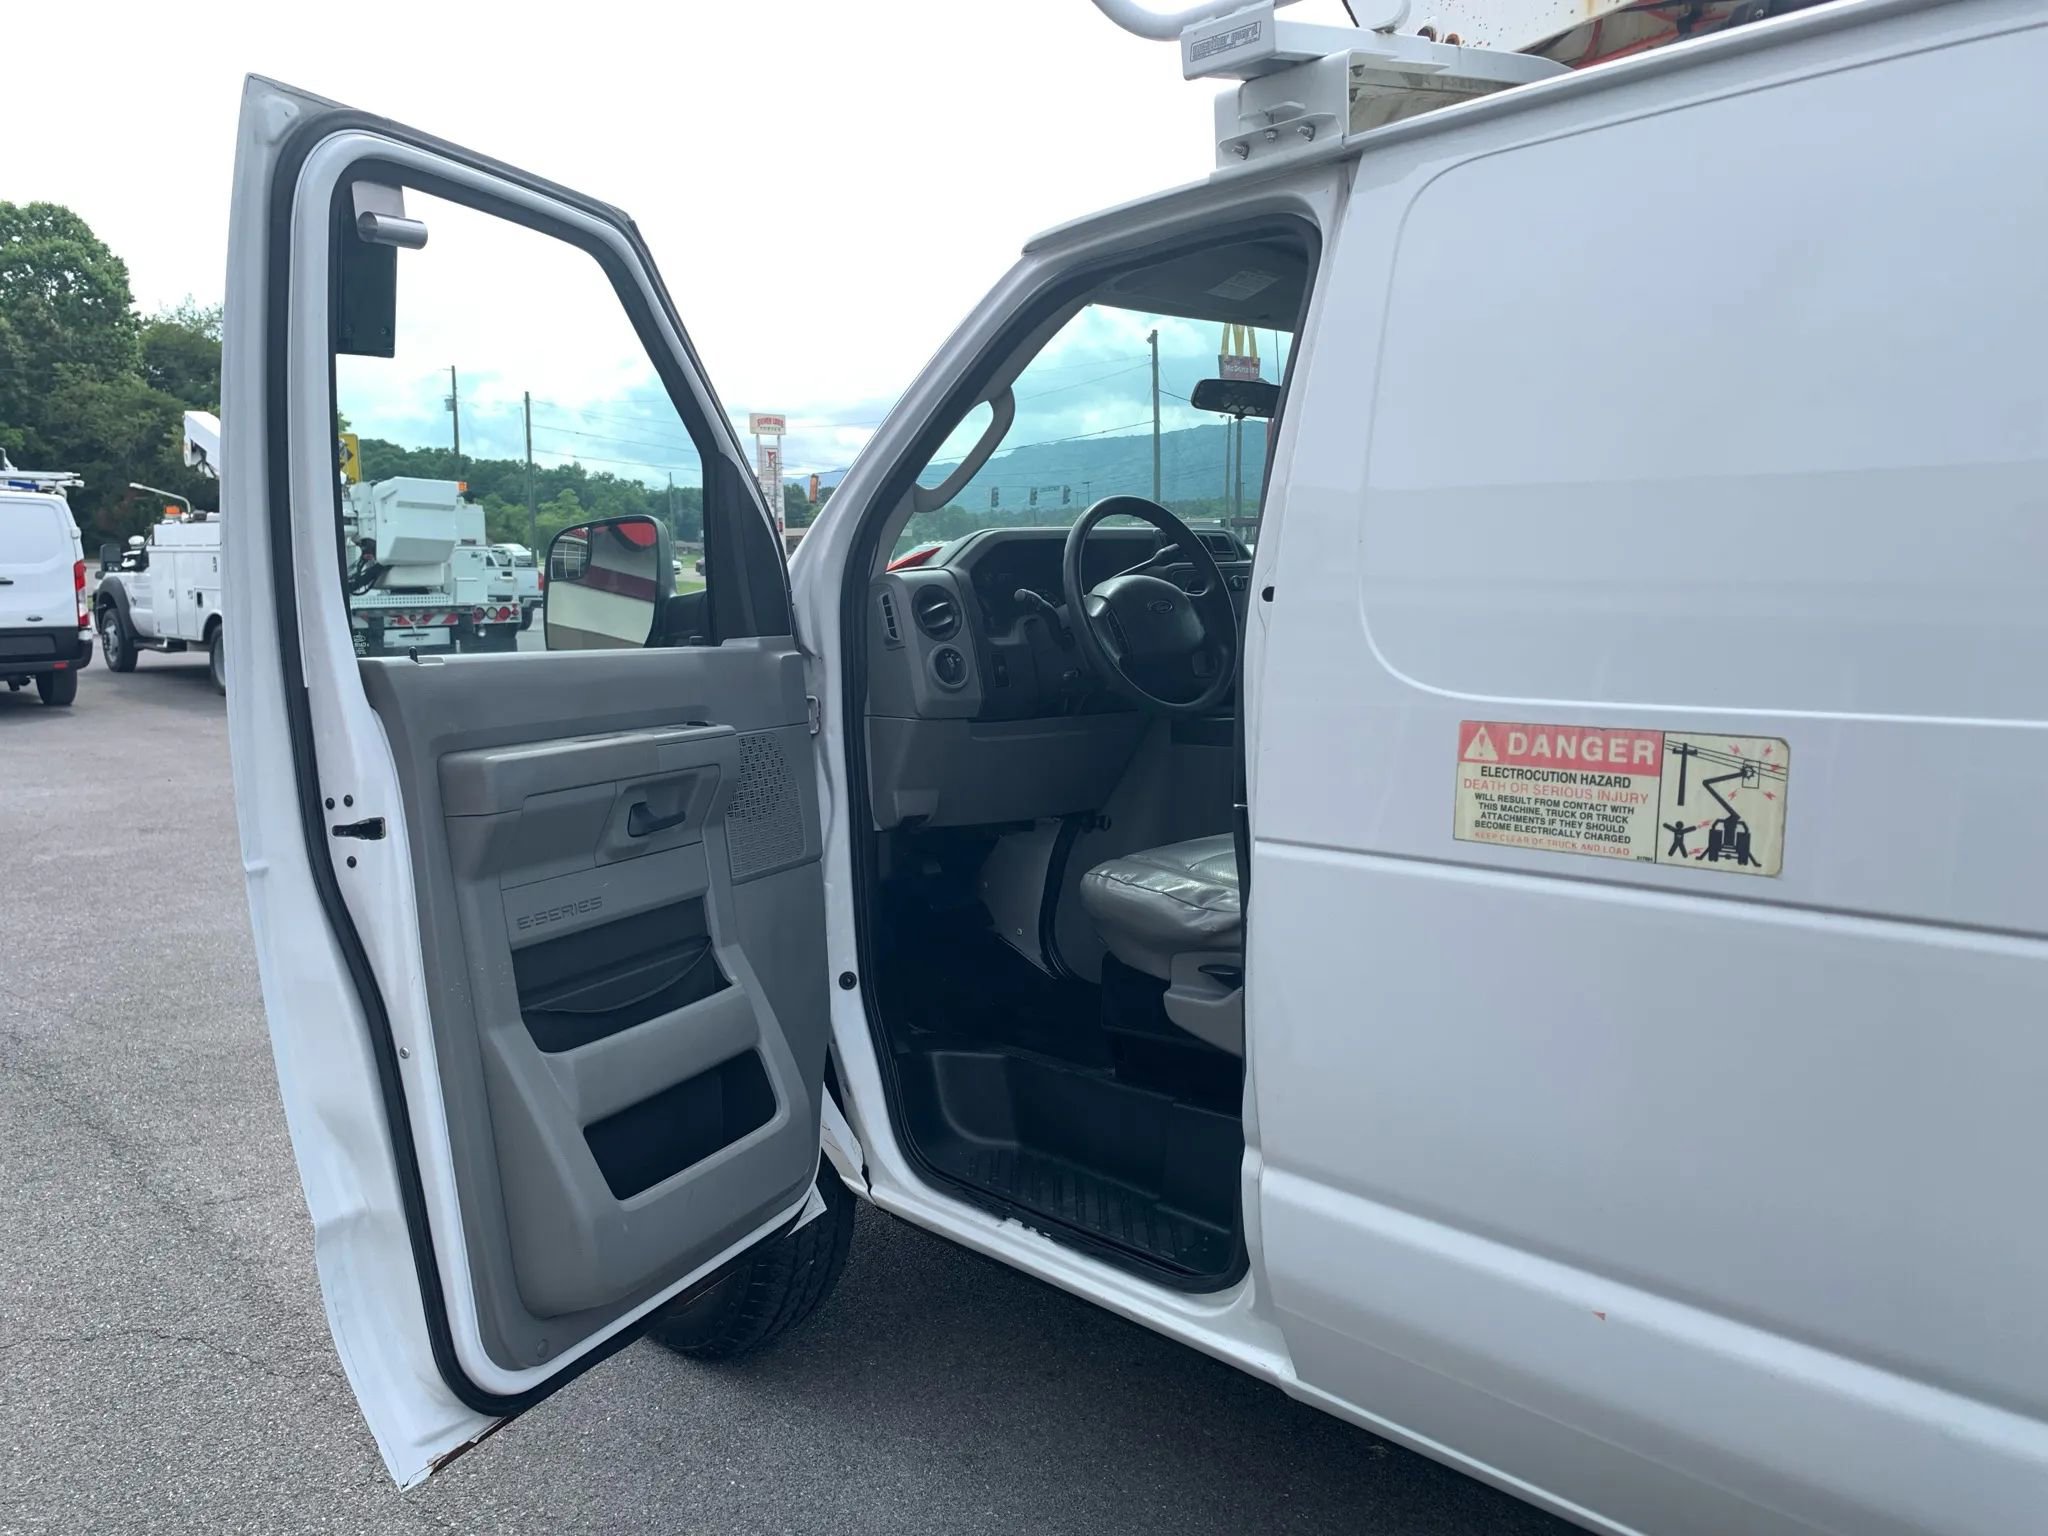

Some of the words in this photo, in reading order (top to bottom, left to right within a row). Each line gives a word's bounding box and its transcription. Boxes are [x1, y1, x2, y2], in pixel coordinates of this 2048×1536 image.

[1508, 731, 1656, 765] DANGER
[1481, 766, 1577, 784] ELECTROCUTION
[1580, 774, 1631, 789] HAZARD
[1463, 778, 1506, 793] DEATH
[1511, 782, 1529, 794] OR
[1533, 784, 1593, 799] SERIOUS
[1597, 790, 1649, 805] INJURY
[1475, 792, 1495, 802] WILL
[1497, 794, 1532, 805] RESULT
[1534, 798, 1560, 808] FROM
[1563, 800, 1608, 813] CONTACT
[1610, 805, 1635, 815] WITH
[1479, 802, 1498, 812] THIS
[1500, 804, 1543, 817] MACHINE,
[1546, 808, 1577, 819] TRUCK
[1579, 812, 1593, 821] OR
[1596, 814, 1629, 824] TRUCK
[1474, 820, 1511, 831] BECOME
[1514, 824, 1581, 839] ELECTRICALLY
[1584, 832, 1631, 844] CHARGED
[1480, 812, 1546, 826] ATTACHMENTS
[1548, 818, 1557, 827] IF
[1559, 819, 1583, 829] THEY
[1585, 822, 1625, 834] SHOULD
[1474, 832, 1498, 841] KEEP
[1499, 834, 1529, 844] CLEAR
[1546, 839, 1577, 850] TRUCK
[1581, 843, 1601, 853] AND
[1603, 846, 1630, 857] LOAD
